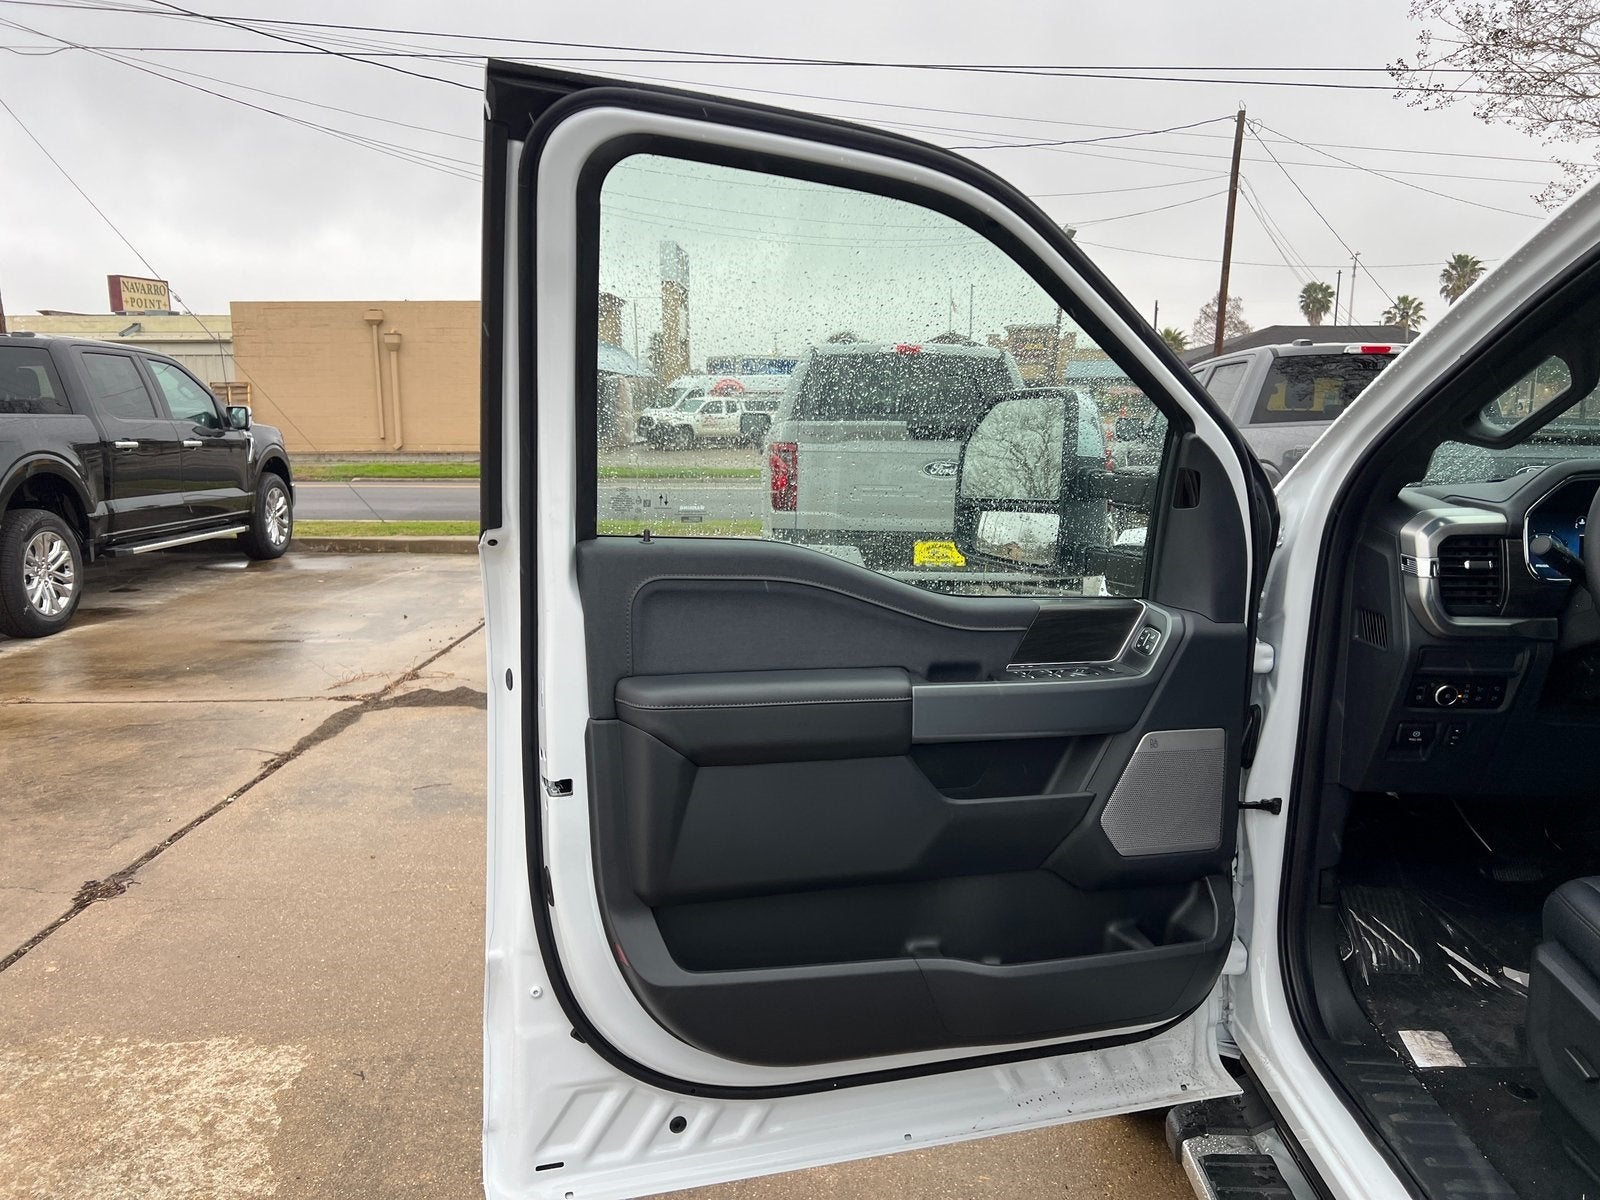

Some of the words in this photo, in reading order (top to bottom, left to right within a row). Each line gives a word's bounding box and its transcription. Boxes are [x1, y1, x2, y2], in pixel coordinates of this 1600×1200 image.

[121, 280, 167, 297] NAVARRO
[130, 297, 162, 309] POINT
[929, 461, 959, 476] Ford
